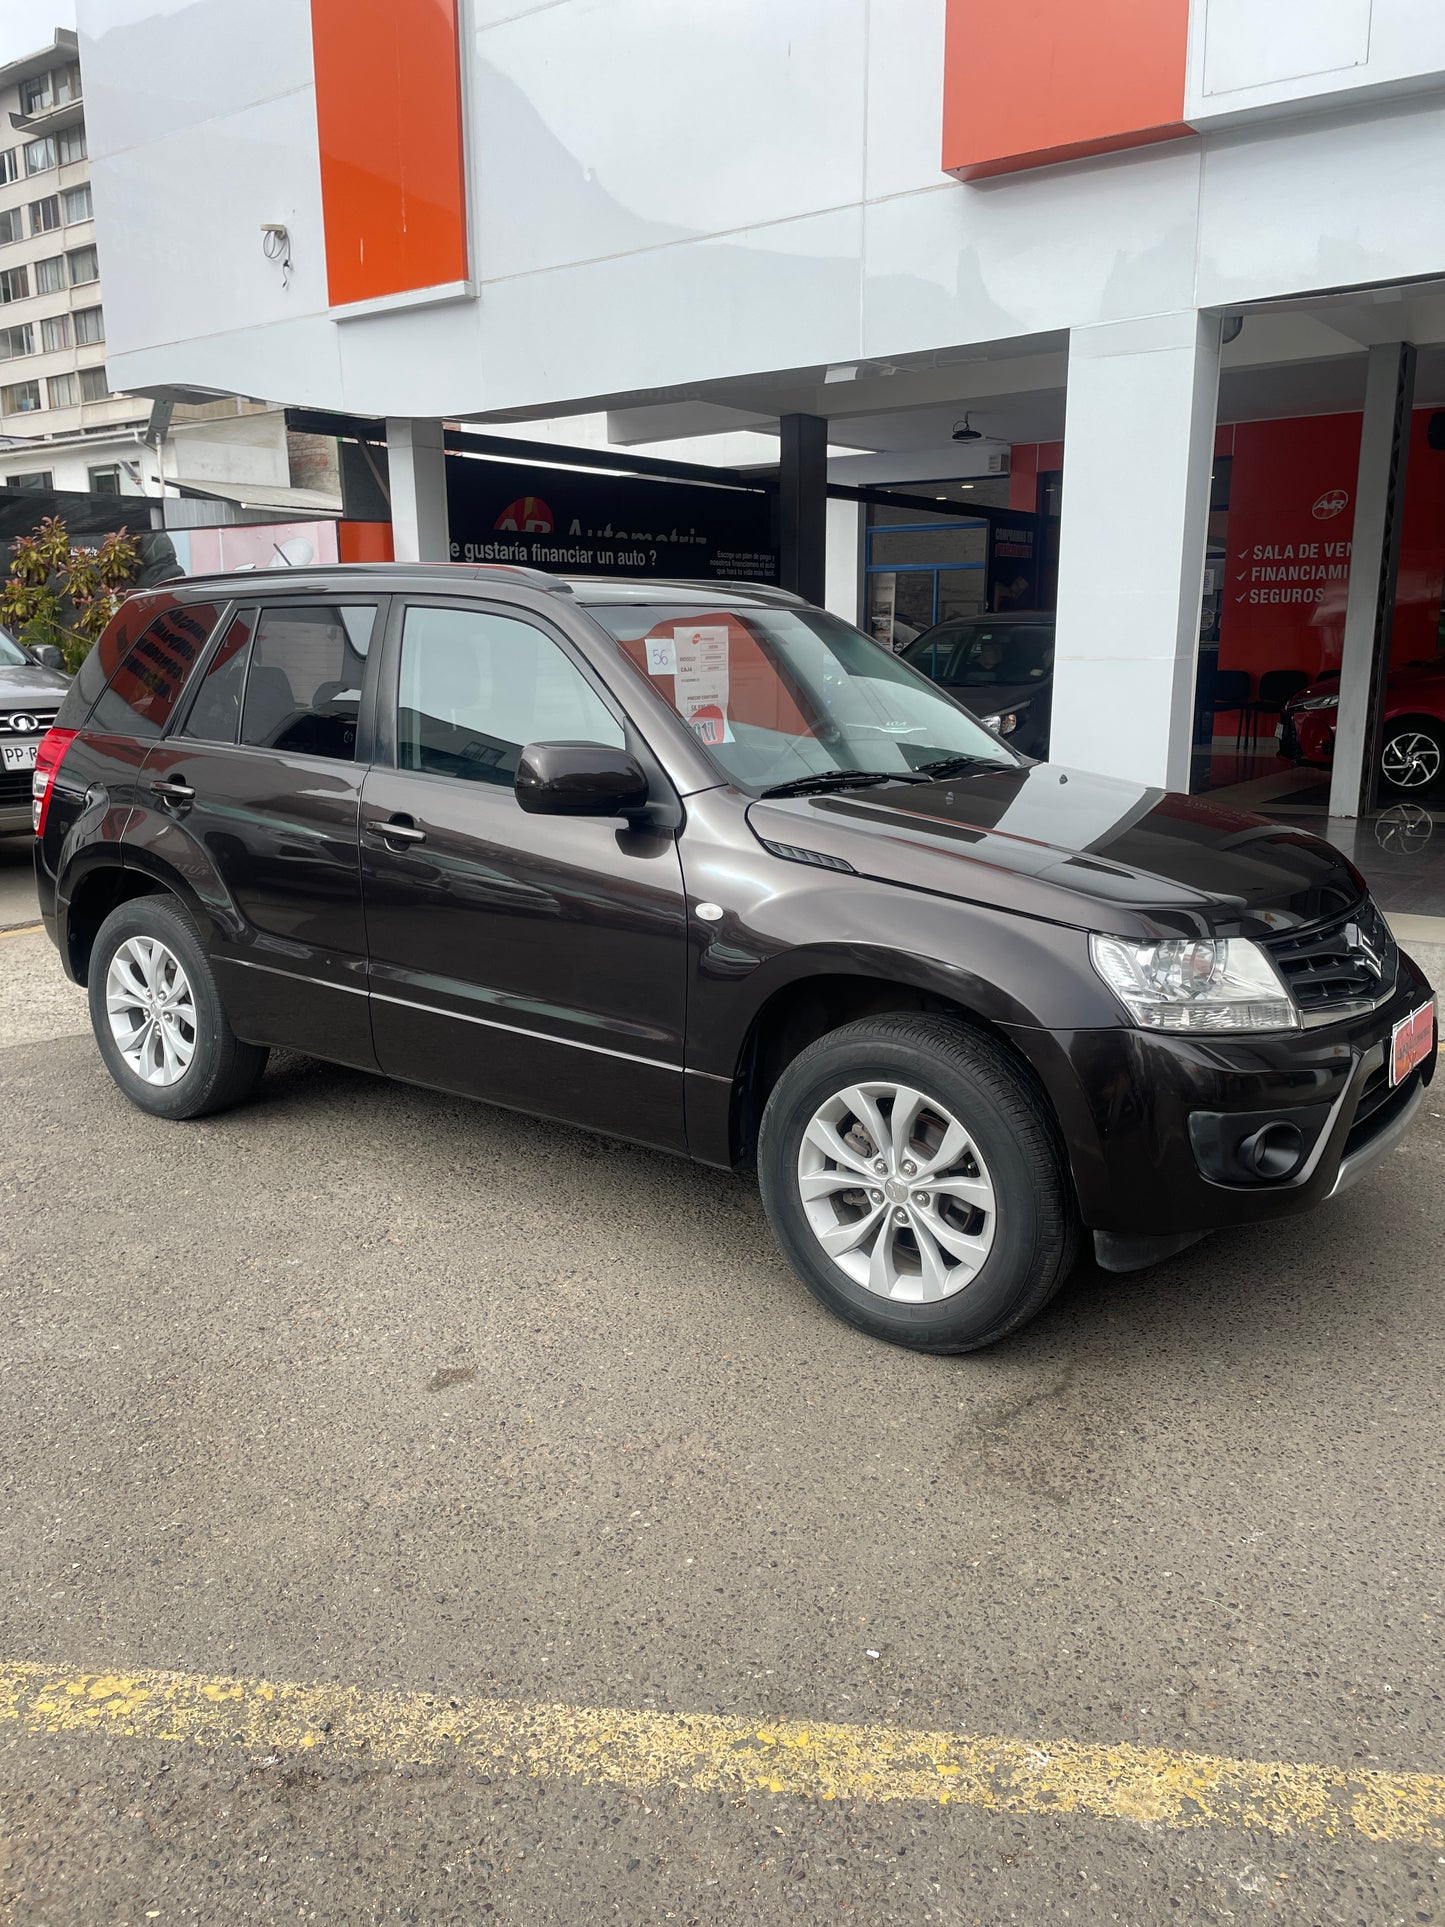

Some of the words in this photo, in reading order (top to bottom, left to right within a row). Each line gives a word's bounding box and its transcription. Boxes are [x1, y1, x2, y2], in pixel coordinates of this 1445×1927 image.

[449, 542, 460, 557] e
[464, 542, 528, 561] gustaría
[531, 544, 593, 564] financiar
[597, 550, 614, 565] un
[617, 550, 646, 566] auto
[1253, 544, 1294, 560] SALA
[1299, 543, 1319, 559] DE
[1251, 564, 1348, 582] FINANCIAMI
[1249, 588, 1325, 604] SEGUROS
[652, 649, 669, 666] 56
